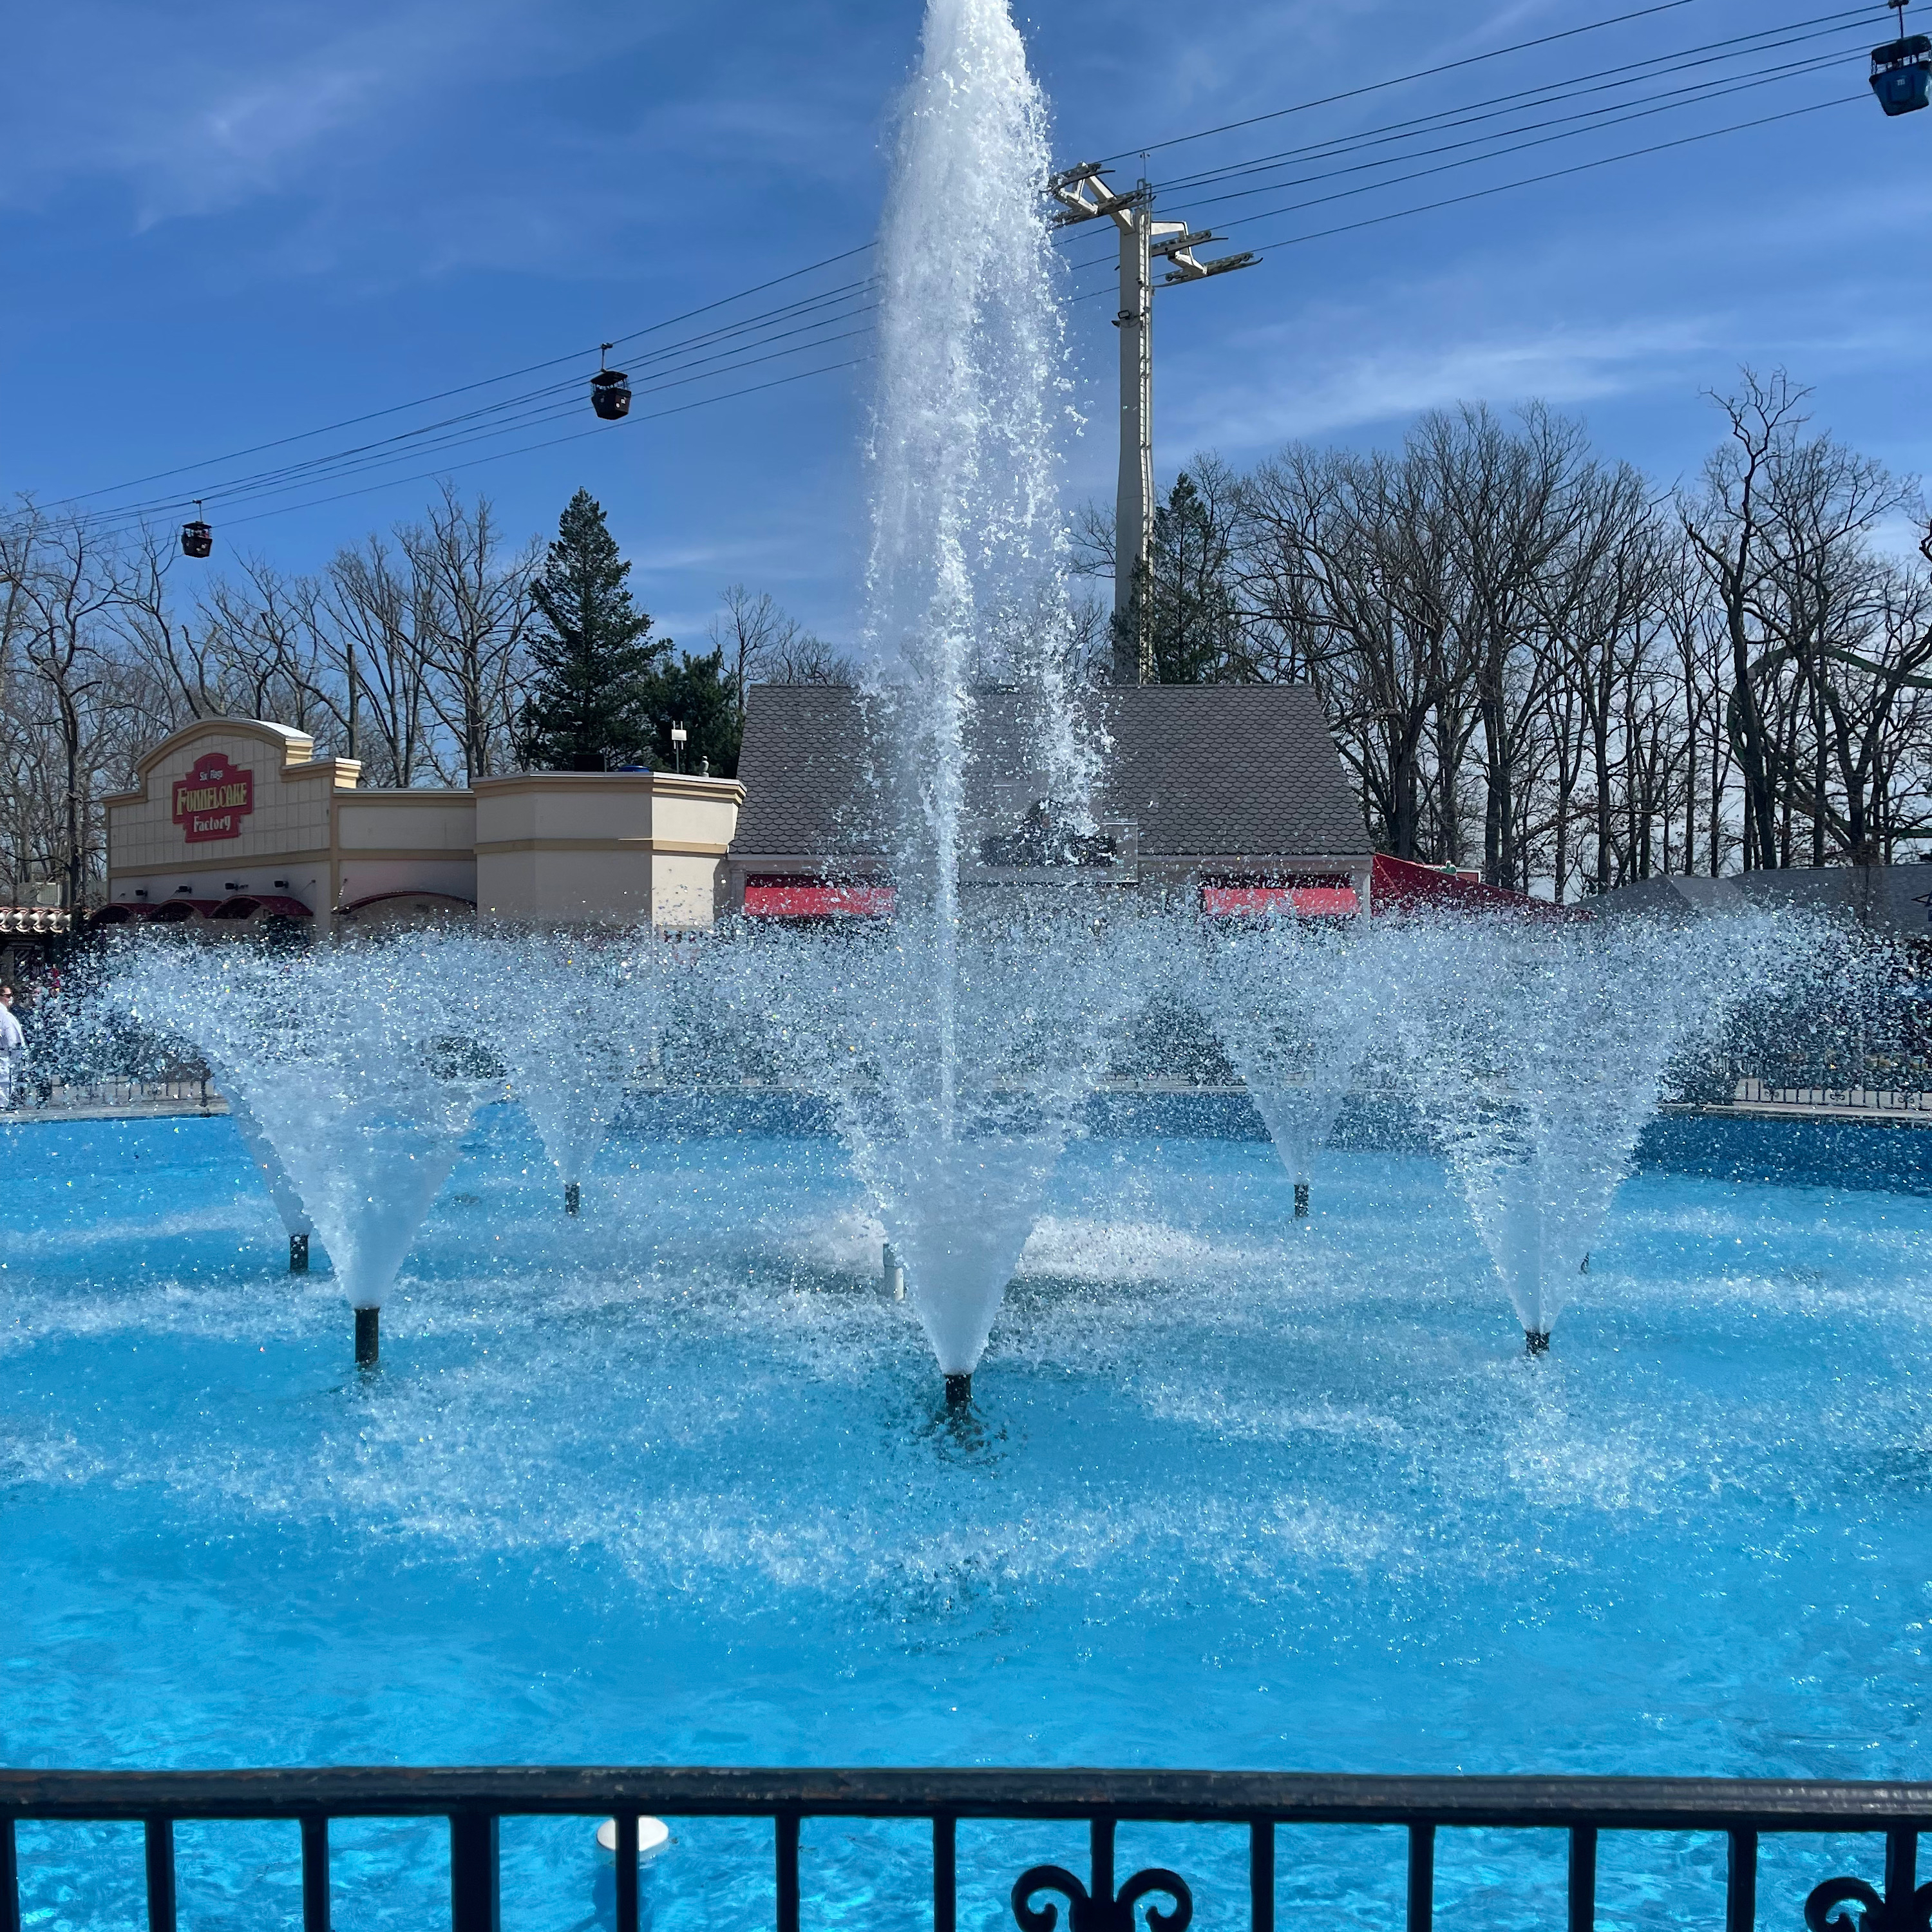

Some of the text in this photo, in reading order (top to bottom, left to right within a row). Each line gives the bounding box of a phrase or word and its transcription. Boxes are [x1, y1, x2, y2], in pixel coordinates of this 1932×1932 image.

[176, 782, 247, 815] FUNNEL CAKE
[193, 815, 231, 833] Factory
